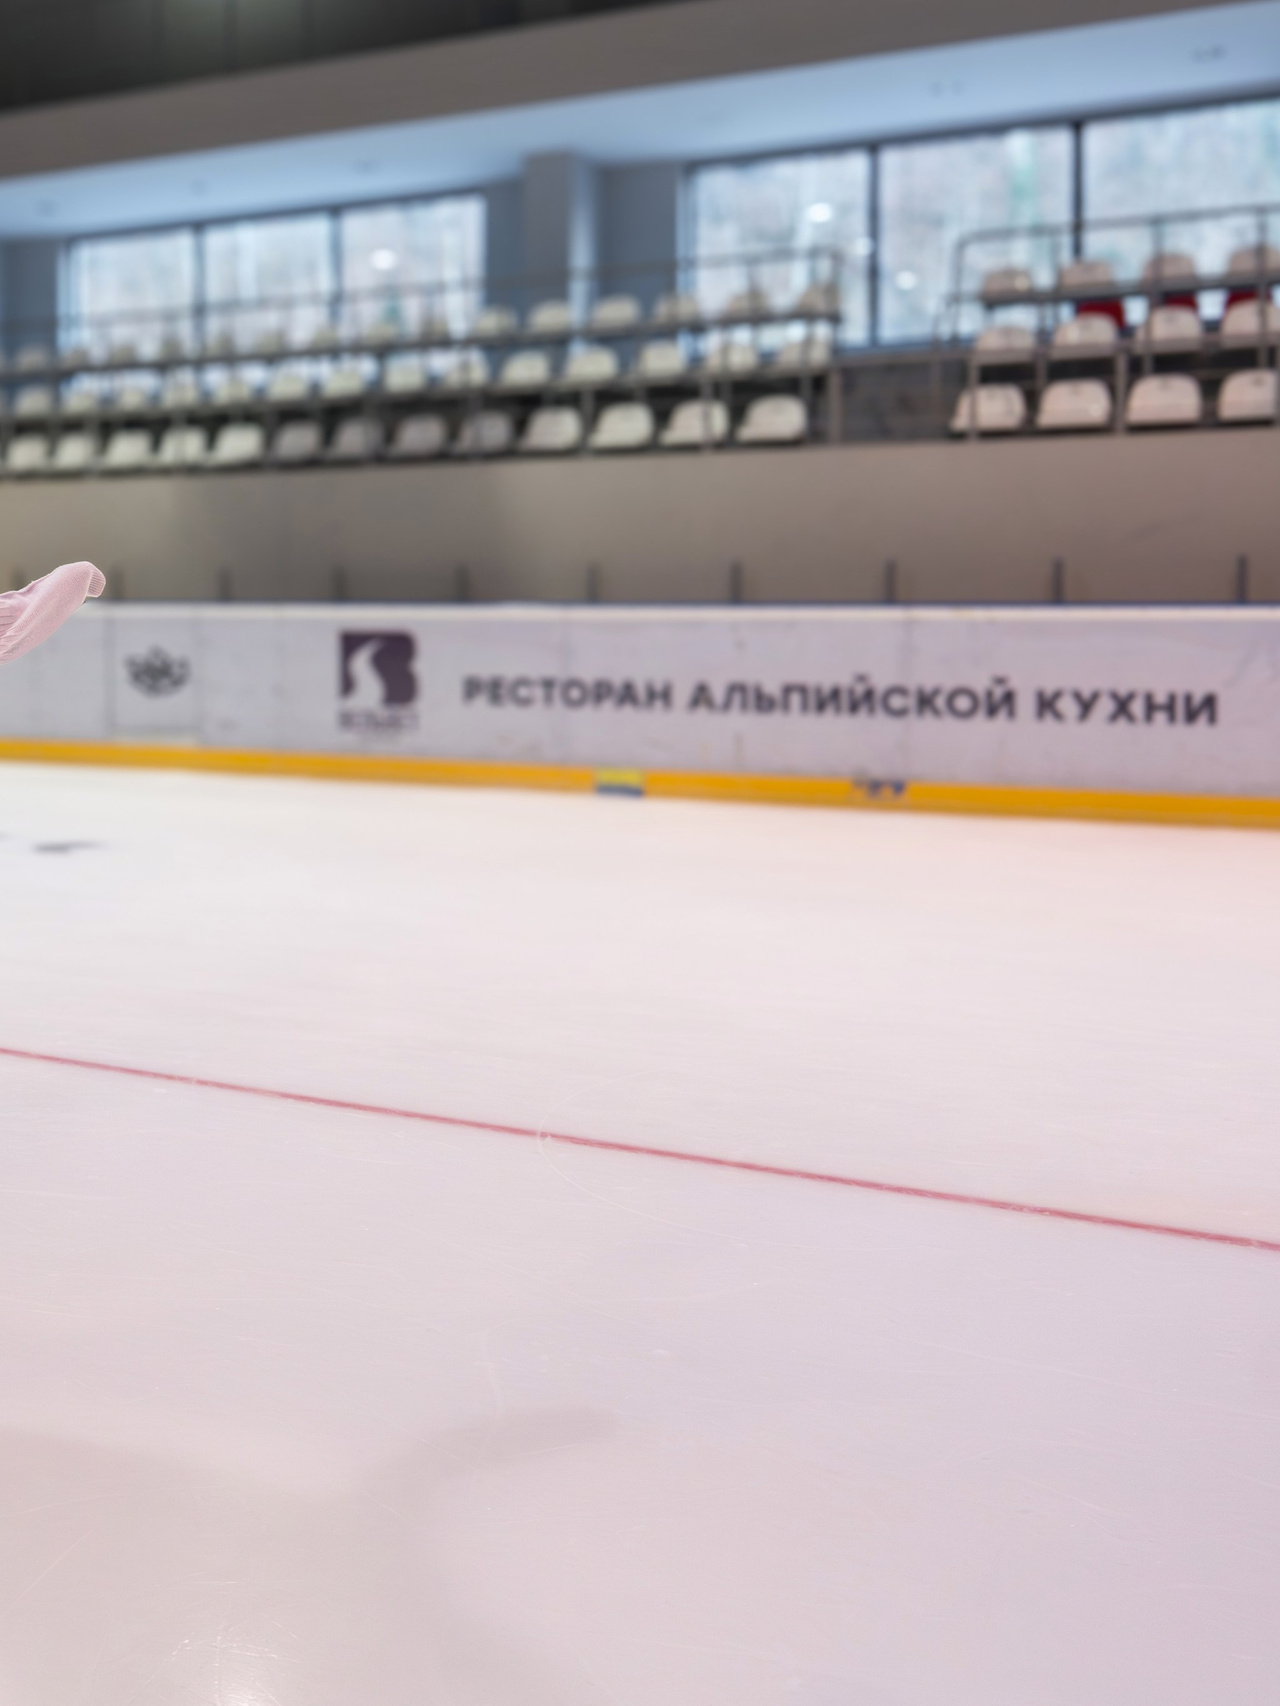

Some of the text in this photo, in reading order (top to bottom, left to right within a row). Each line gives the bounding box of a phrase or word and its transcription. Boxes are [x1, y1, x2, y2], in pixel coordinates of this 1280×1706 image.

[462, 674, 1219, 727] РЕСТОРАН АЛЬПИЙСКОЙ КУХНИ
